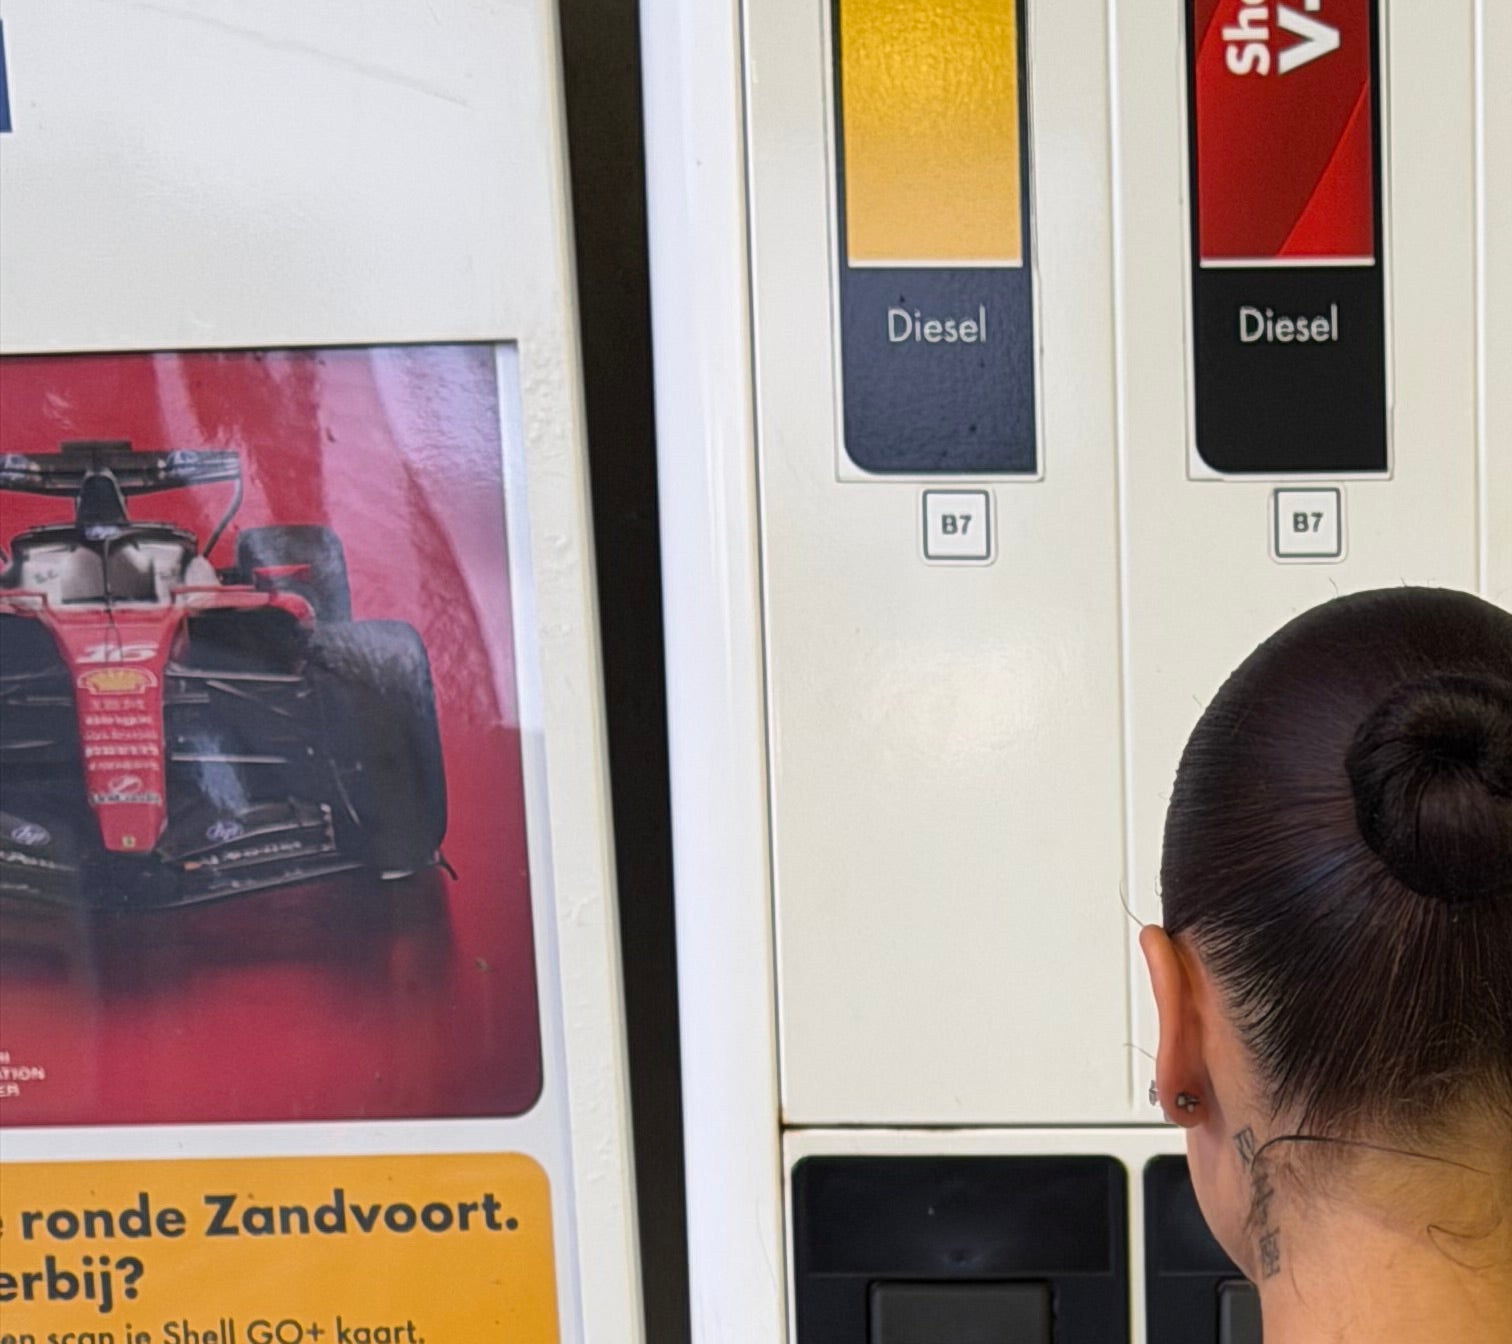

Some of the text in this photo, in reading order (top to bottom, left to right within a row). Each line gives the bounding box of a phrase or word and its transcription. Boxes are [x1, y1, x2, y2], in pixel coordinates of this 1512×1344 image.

[1222, 0, 1271, 76] Sh
[887, 304, 987, 344] Diesel
[1239, 302, 1338, 343] Diesel
[941, 514, 972, 536] B7
[1292, 512, 1324, 533] B7
[21, 1191, 187, 1240] ronde
[204, 1187, 519, 1237] Zandvoort.
